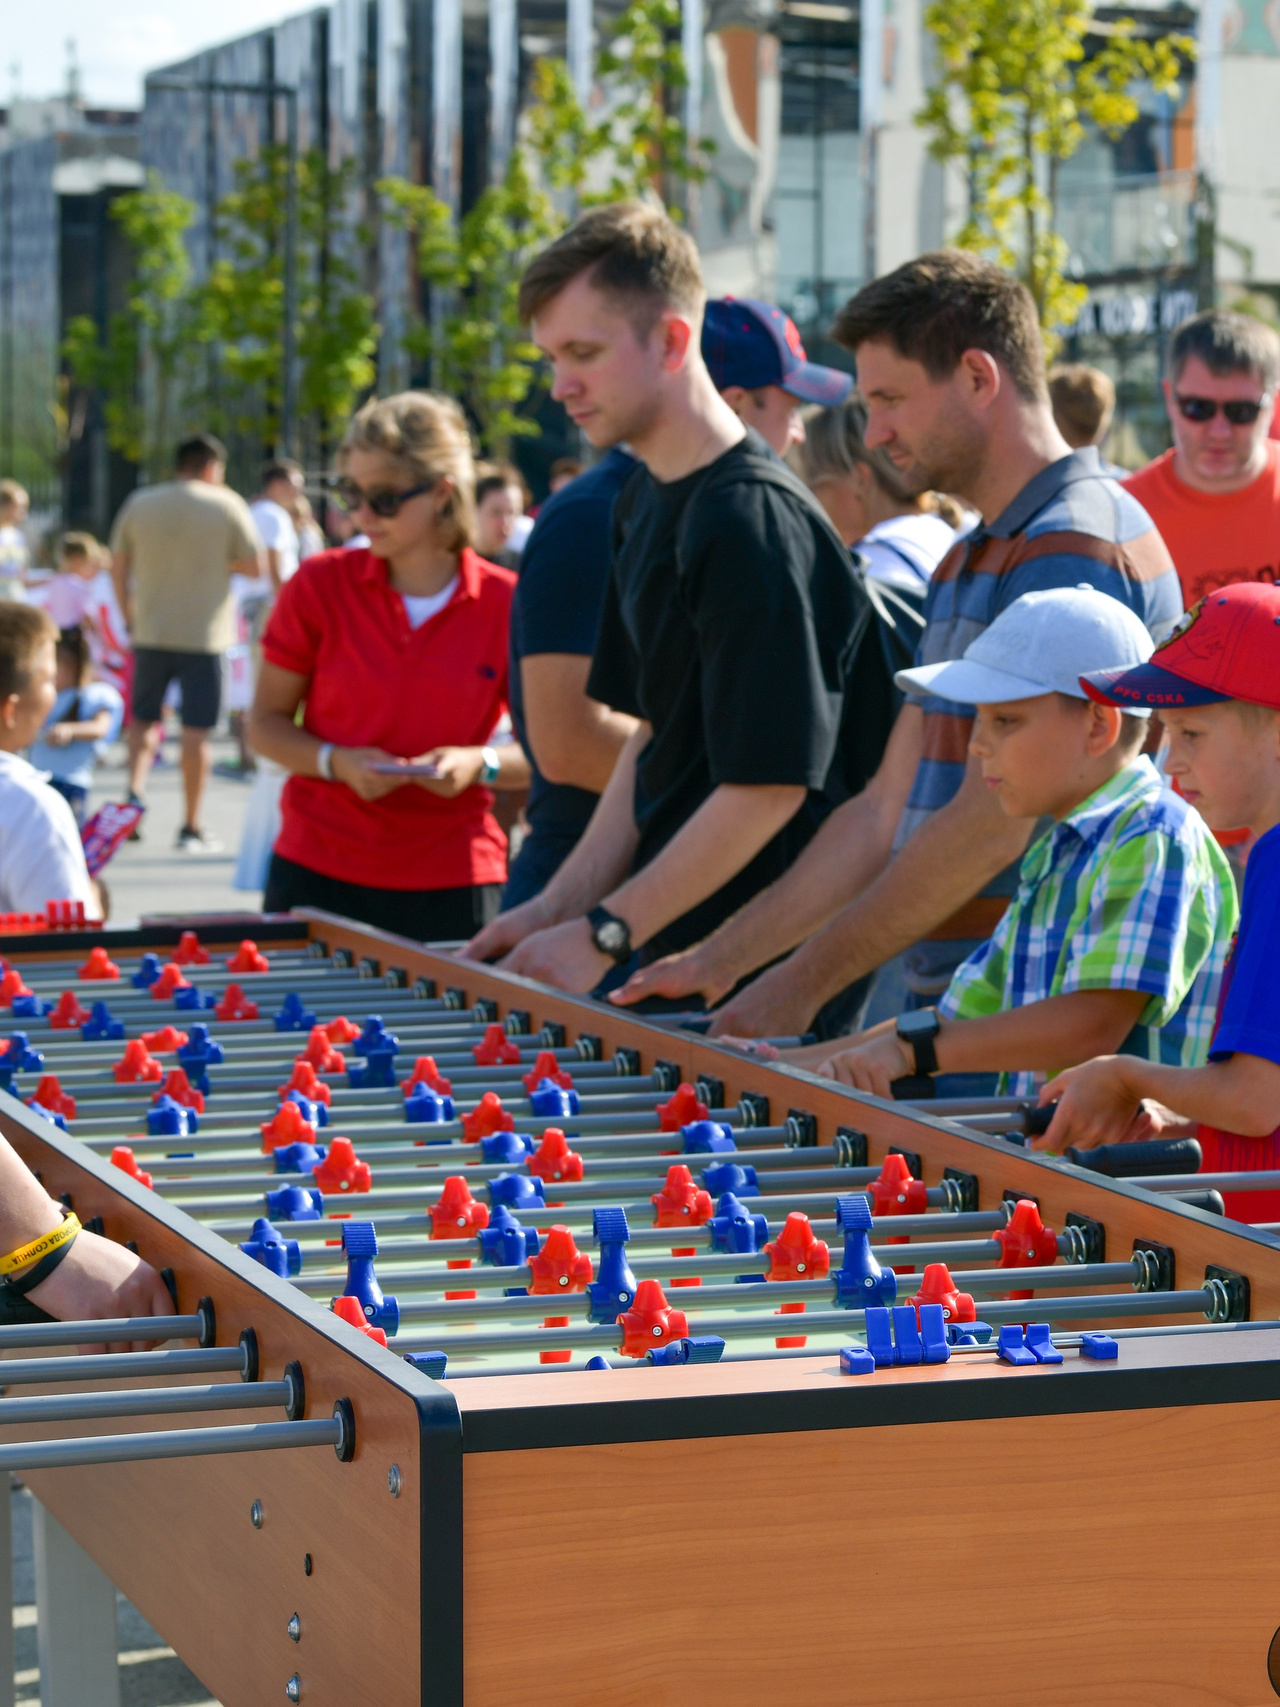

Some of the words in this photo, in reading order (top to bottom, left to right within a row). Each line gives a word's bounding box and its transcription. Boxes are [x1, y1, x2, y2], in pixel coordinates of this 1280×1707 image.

[1113, 685, 1142, 700] PFC
[1146, 692, 1185, 704] CSKA
[49, 1225, 75, 1245] ГОРОДА
[12, 1242, 48, 1265] СОЛНЦА
